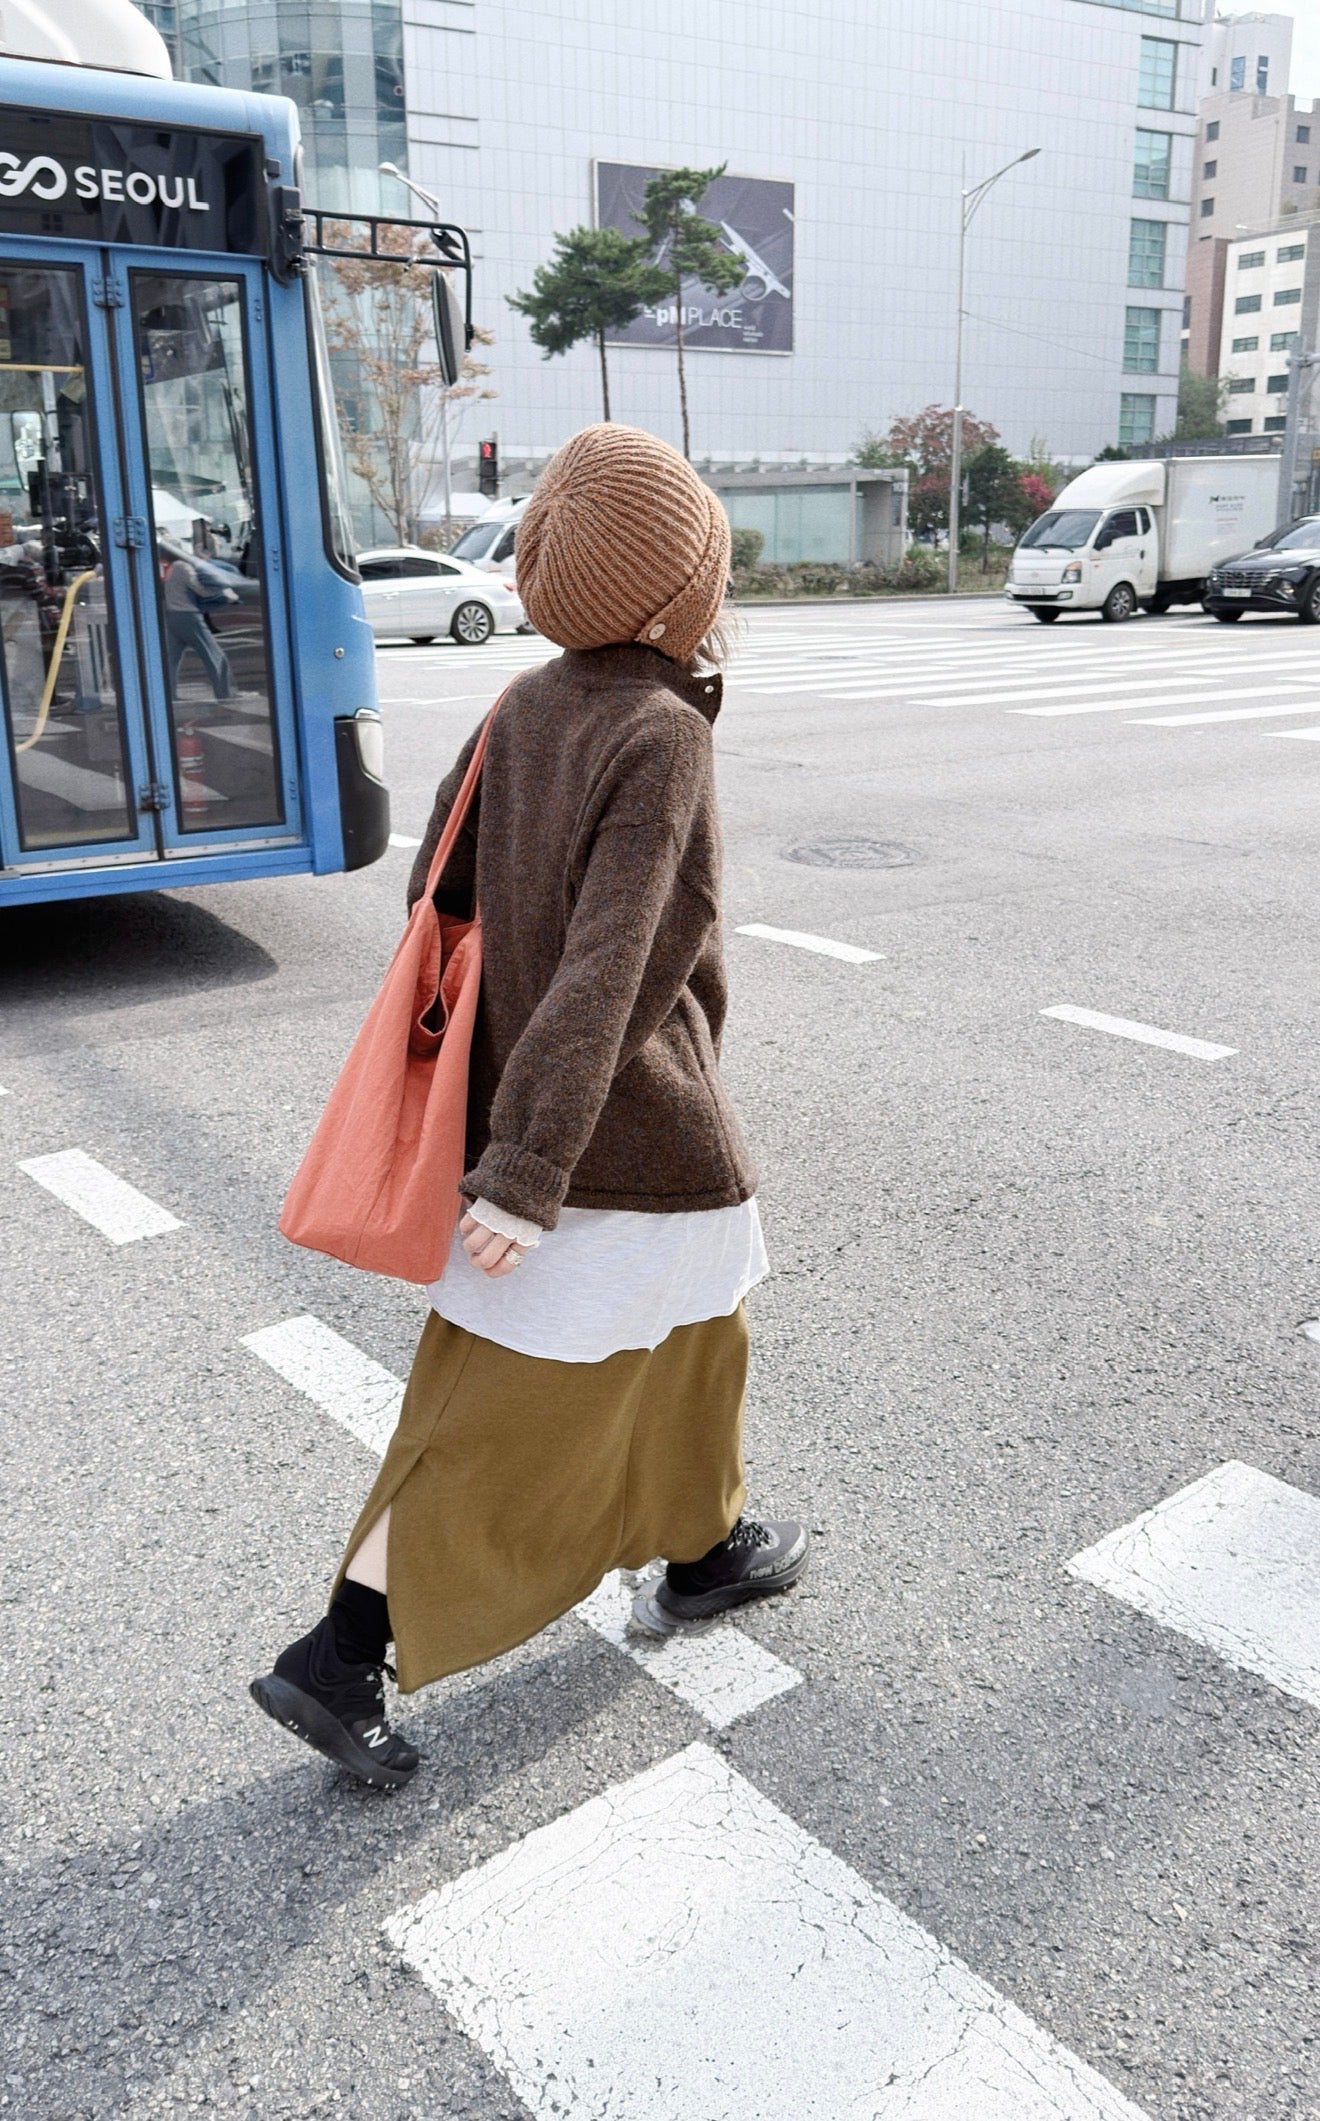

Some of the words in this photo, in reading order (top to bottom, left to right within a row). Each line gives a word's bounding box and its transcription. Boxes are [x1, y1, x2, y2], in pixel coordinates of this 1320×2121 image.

[74, 165, 211, 211] SEOUL
[687, 307, 743, 329] PLACE
[363, 1725, 389, 1749] N
